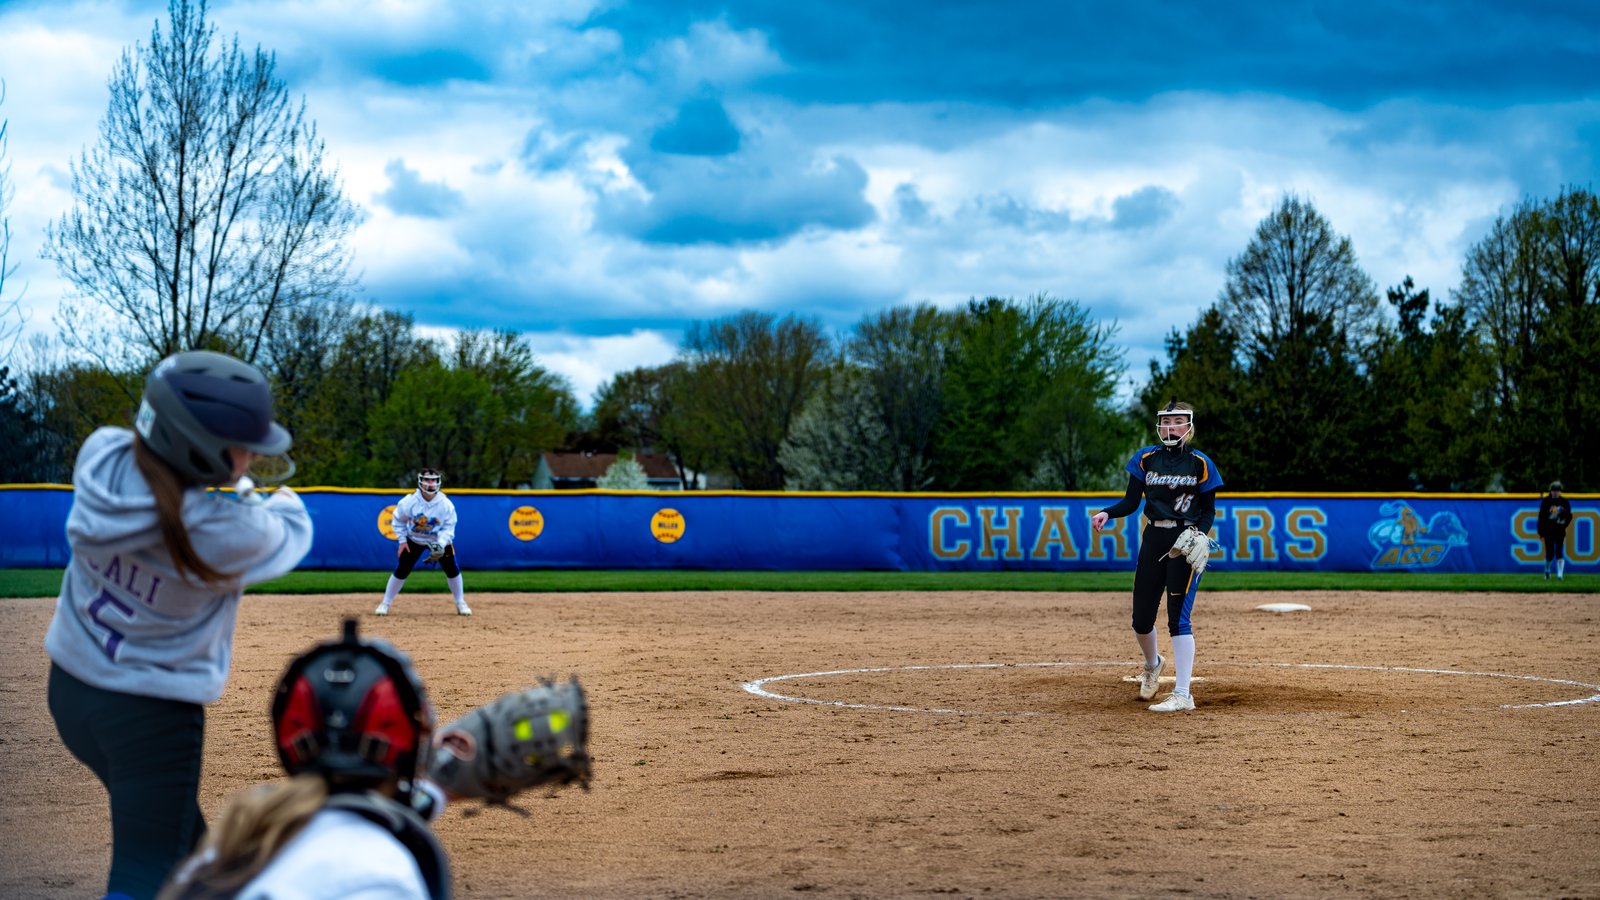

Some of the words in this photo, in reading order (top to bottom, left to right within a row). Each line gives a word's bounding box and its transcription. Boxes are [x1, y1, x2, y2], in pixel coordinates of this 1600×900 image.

[1145, 471, 1198, 489] Chargers
[1174, 493, 1195, 513] 15
[928, 506, 1328, 562] CHARRS
[1375, 544, 1445, 567] ACC
[86, 555, 162, 605] ALI
[85, 587, 136, 663] 5
